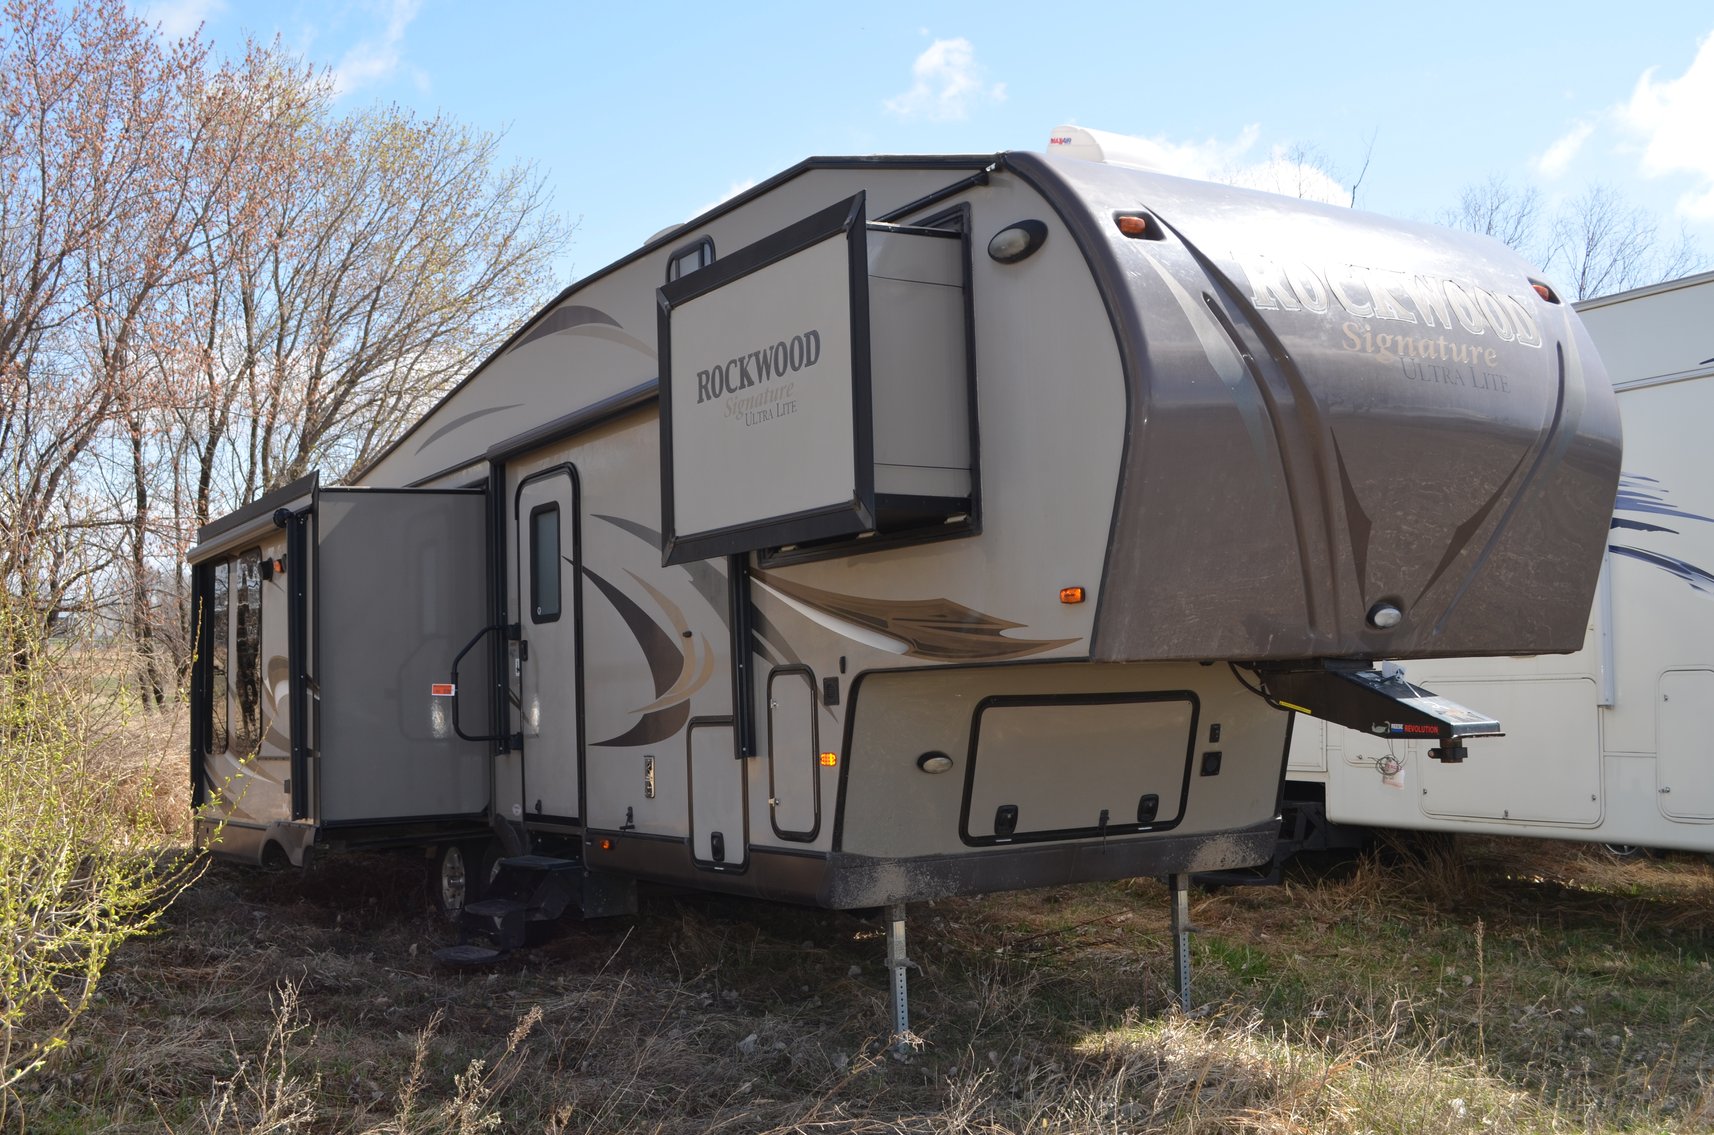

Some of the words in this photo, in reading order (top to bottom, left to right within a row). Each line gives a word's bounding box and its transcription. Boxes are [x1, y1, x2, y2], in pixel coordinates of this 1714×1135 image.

[1231, 251, 1543, 348] ROCKWOOD
[1342, 321, 1499, 368] Signature
[697, 329, 821, 404] ROCKWOOD
[1400, 357, 1465, 388] ULTRA
[1469, 366, 1512, 394] LITE
[723, 382, 795, 421] Signature
[745, 408, 774, 427] ULTRA
[776, 400, 798, 418] LITE
[1404, 723, 1439, 734] REVOLUTION
